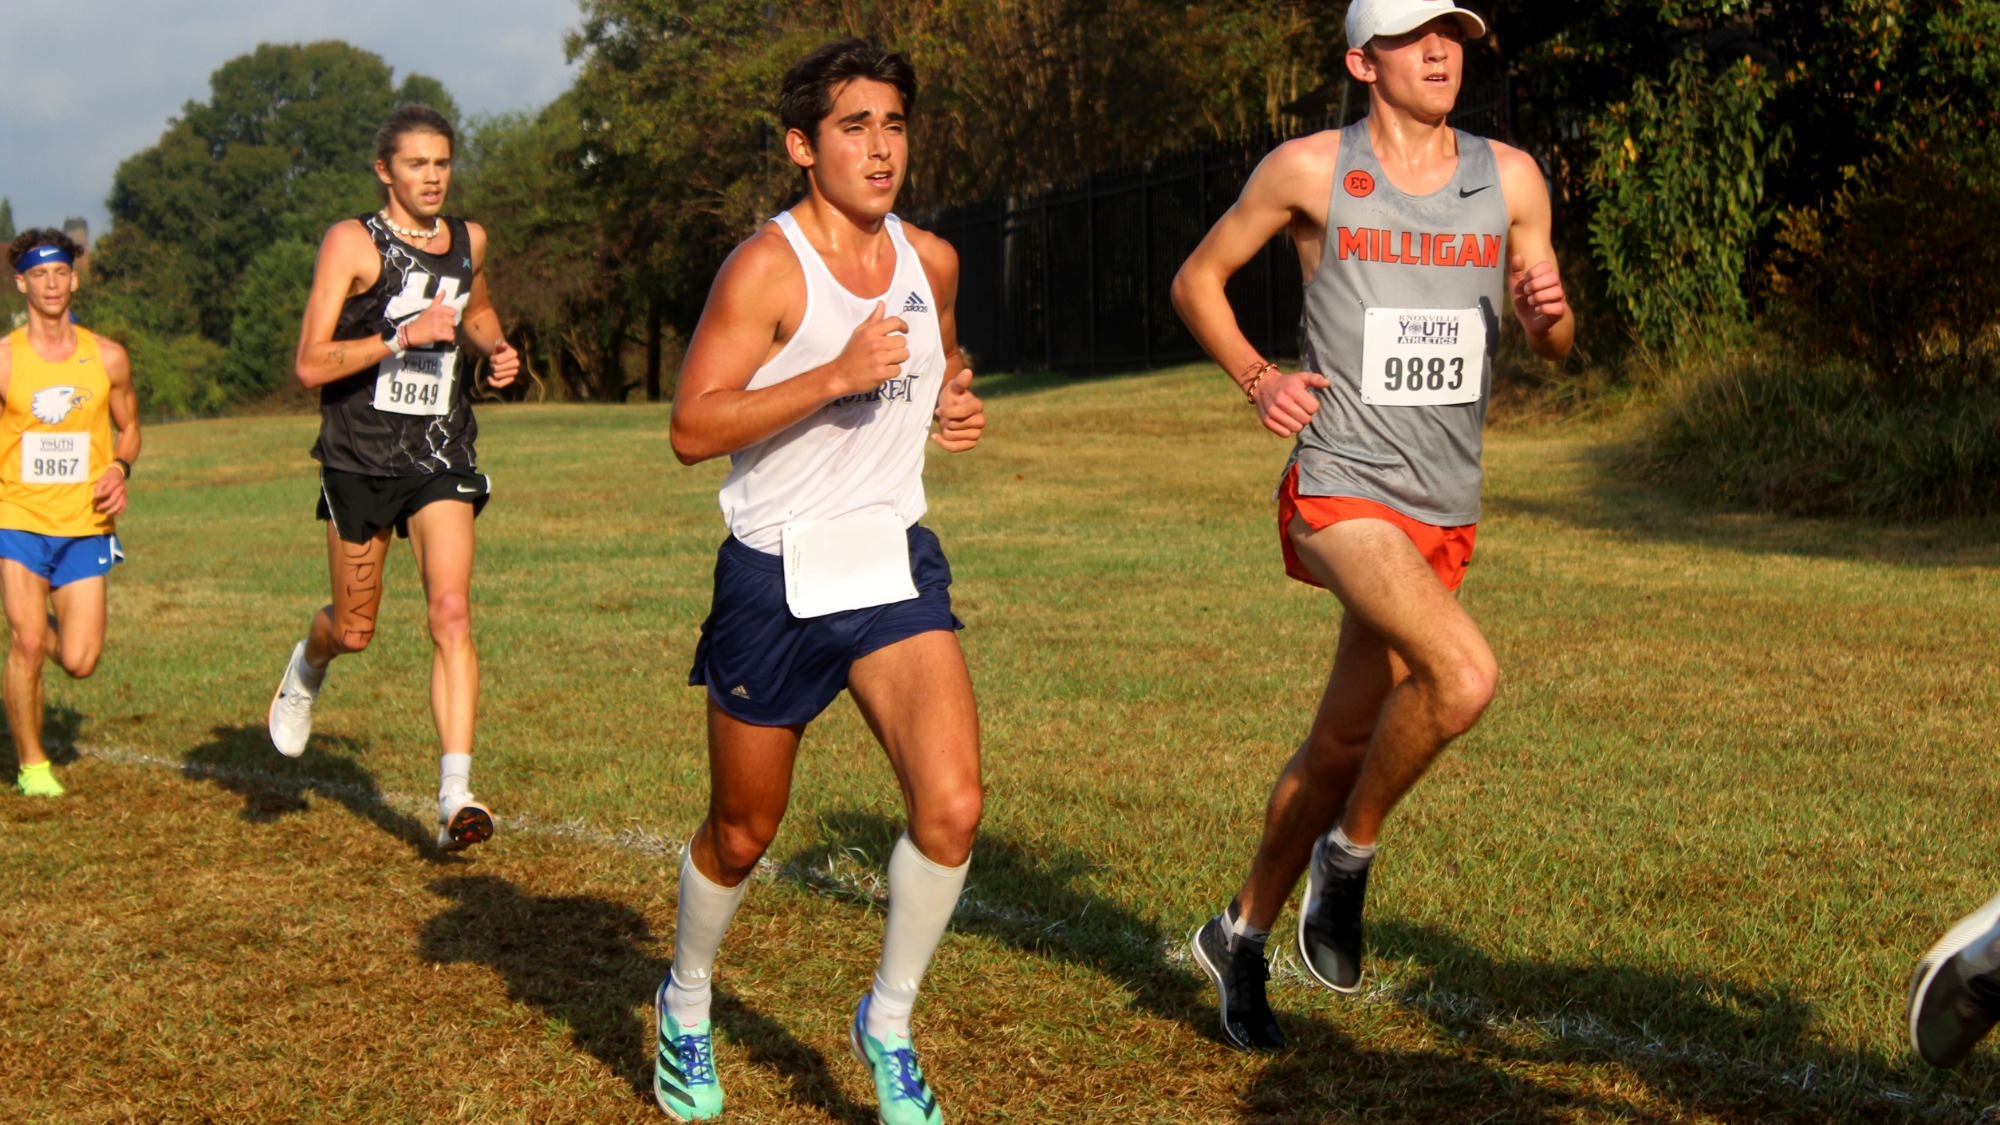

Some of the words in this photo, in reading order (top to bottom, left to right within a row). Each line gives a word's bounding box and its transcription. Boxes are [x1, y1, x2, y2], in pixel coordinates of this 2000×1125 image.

[1337, 226, 1501, 268] MILLIGAN
[903, 303, 928, 313] adidas
[1399, 314, 1460, 322] KNOXVILLE
[1399, 336, 1457, 345] ATHLETICS
[1384, 357, 1464, 391] 9883
[389, 381, 439, 406] 9849
[34, 458, 79, 476] 9867
